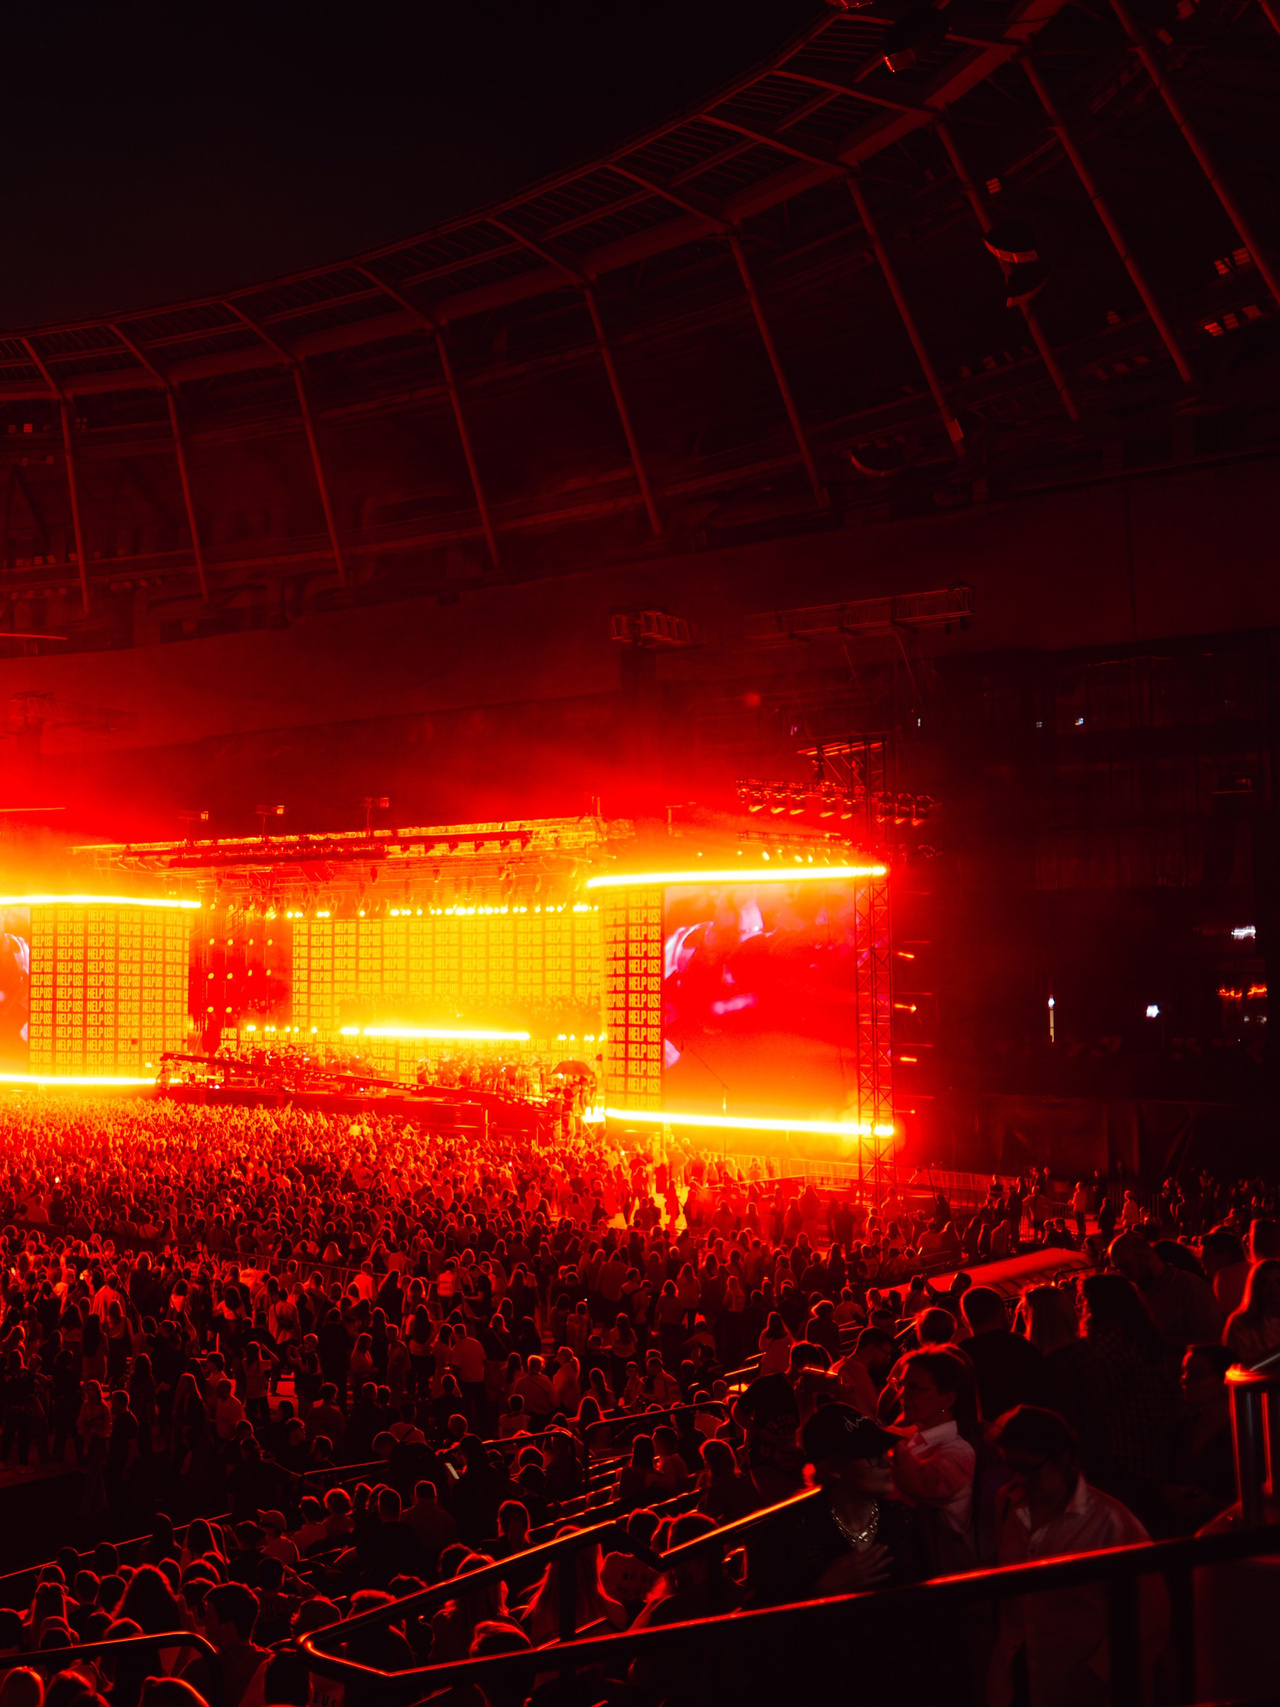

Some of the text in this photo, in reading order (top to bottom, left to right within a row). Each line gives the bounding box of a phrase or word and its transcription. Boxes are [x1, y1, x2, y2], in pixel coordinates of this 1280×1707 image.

[628, 892, 661, 906] HELP US!
[628, 909, 661, 923] HELP US!
[32, 923, 44, 934] HELP
[57, 923, 72, 934] HELP
[88, 923, 104, 934] HELP
[628, 926, 661, 940] HELP US!
[32, 936, 44, 947] HELP
[57, 936, 72, 947] HELP
[88, 936, 104, 947] HELP
[32, 948, 44, 960] HELP
[57, 948, 72, 960] HELP
[87, 948, 104, 960] HELP
[628, 942, 661, 957] HELP US!
[31, 961, 44, 972] HELP
[57, 962, 72, 973] HELP
[87, 961, 104, 973] HELP
[628, 959, 661, 974] HELP US!
[31, 974, 43, 986] HELP
[57, 974, 72, 986] HELP
[87, 975, 104, 986] HELP
[628, 976, 661, 991] HELP US!
[31, 987, 43, 998] HELP
[56, 987, 72, 999] HELP
[87, 988, 104, 999] HELP
[31, 1000, 43, 1011] HELP
[56, 1000, 72, 1012] HELP
[87, 1001, 104, 1012] HELP
[628, 993, 661, 1008] HELP US!
[30, 1013, 43, 1024] HELP
[56, 1013, 72, 1025] HELP
[87, 1014, 103, 1025] HELP
[628, 1010, 661, 1025] HELP US!
[30, 1026, 43, 1037] HELP
[56, 1026, 72, 1038] HELP
[87, 1027, 103, 1038] HELP
[628, 1027, 661, 1042] HELP US!
[30, 1038, 42, 1050] HELP
[56, 1040, 72, 1051] HELP
[86, 1040, 103, 1051] HELP
[628, 1044, 661, 1059] HELP US!
[628, 1061, 661, 1075] HELP US!
[628, 1078, 661, 1093] HELP US!
